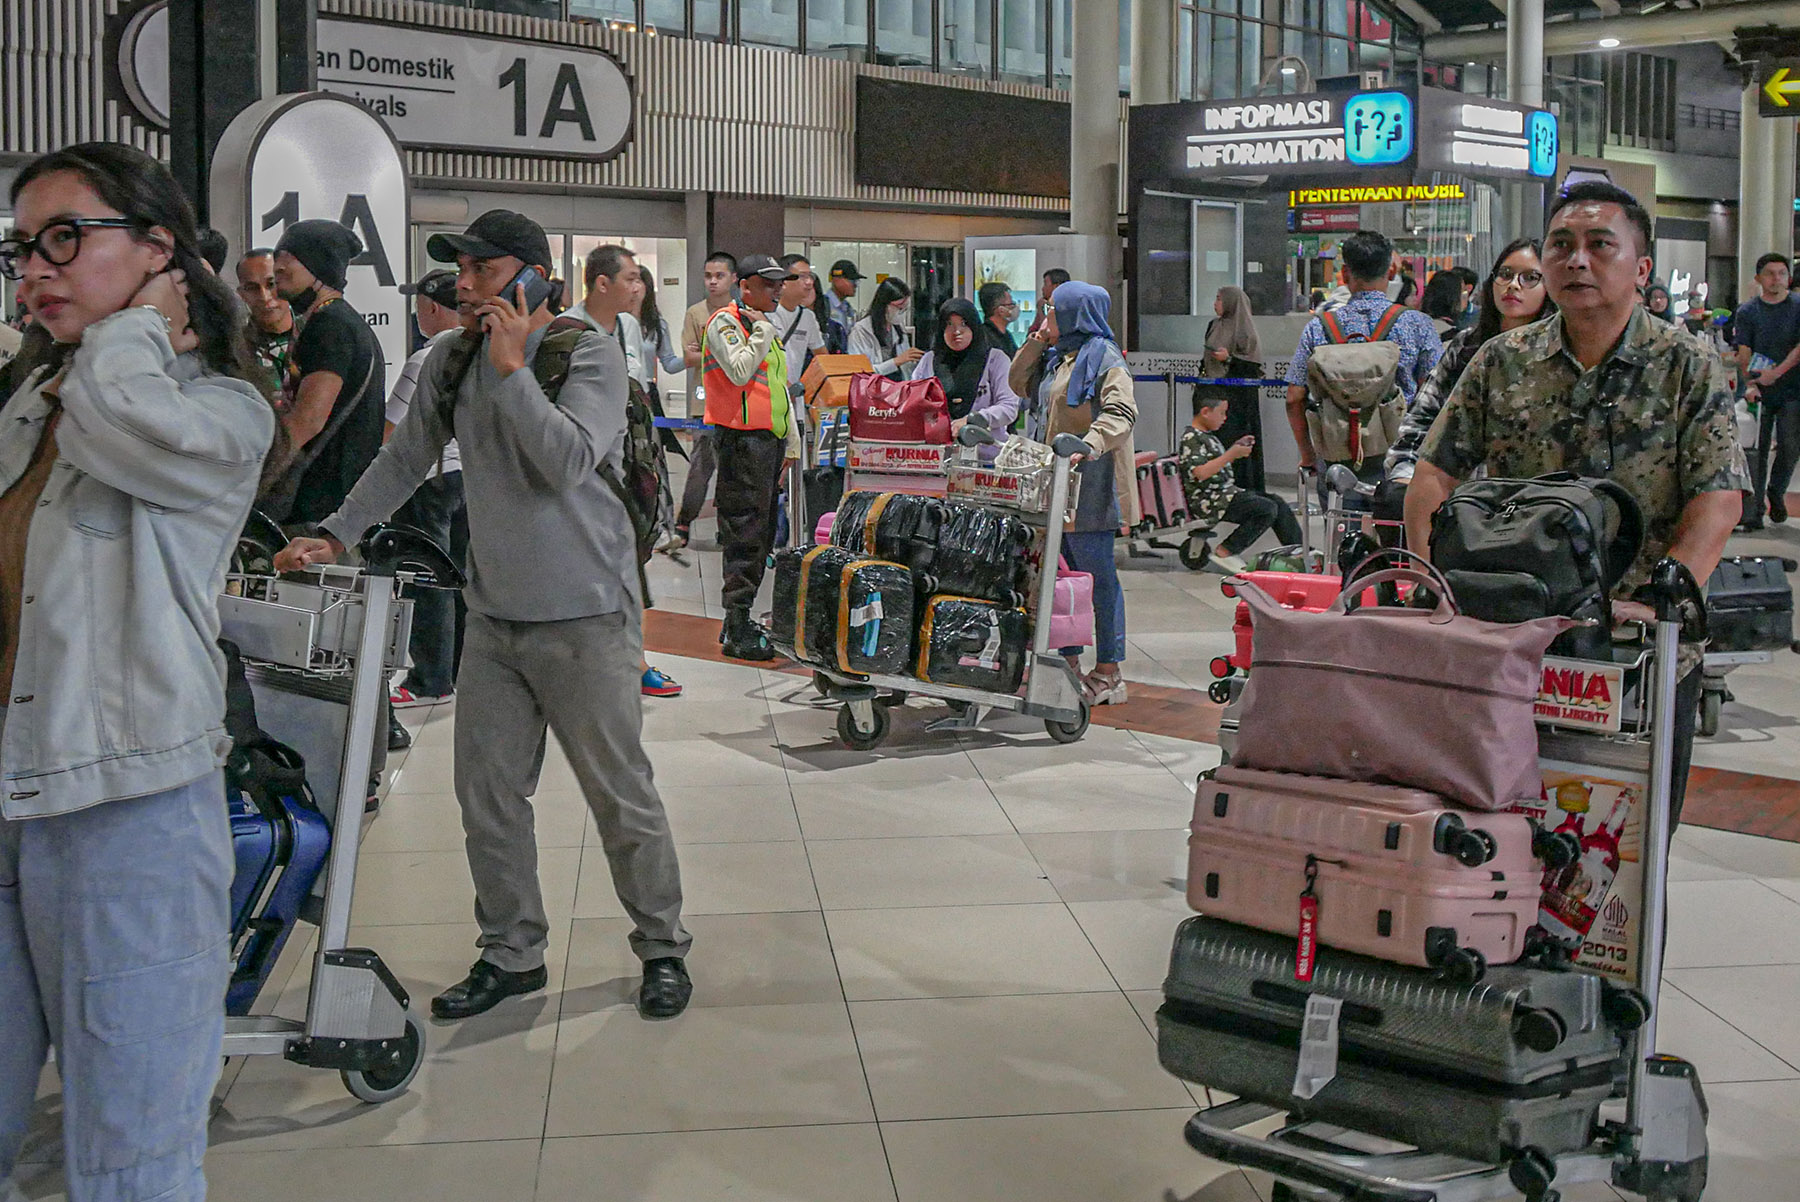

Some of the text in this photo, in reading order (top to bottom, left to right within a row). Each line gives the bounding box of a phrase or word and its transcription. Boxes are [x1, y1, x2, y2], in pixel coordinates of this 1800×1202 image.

[348, 48, 455, 81] Domestik
[498, 57, 597, 142] 1A
[1186, 137, 1345, 168] INFORMATION
[1405, 184, 1465, 200] MOBIL
[361, 312, 389, 326] an
[868, 406, 897, 420] Beryl's
[1538, 665, 1612, 704] NIA
[1562, 706, 1610, 725] LIBERTY
[1583, 941, 1628, 962] 2013
